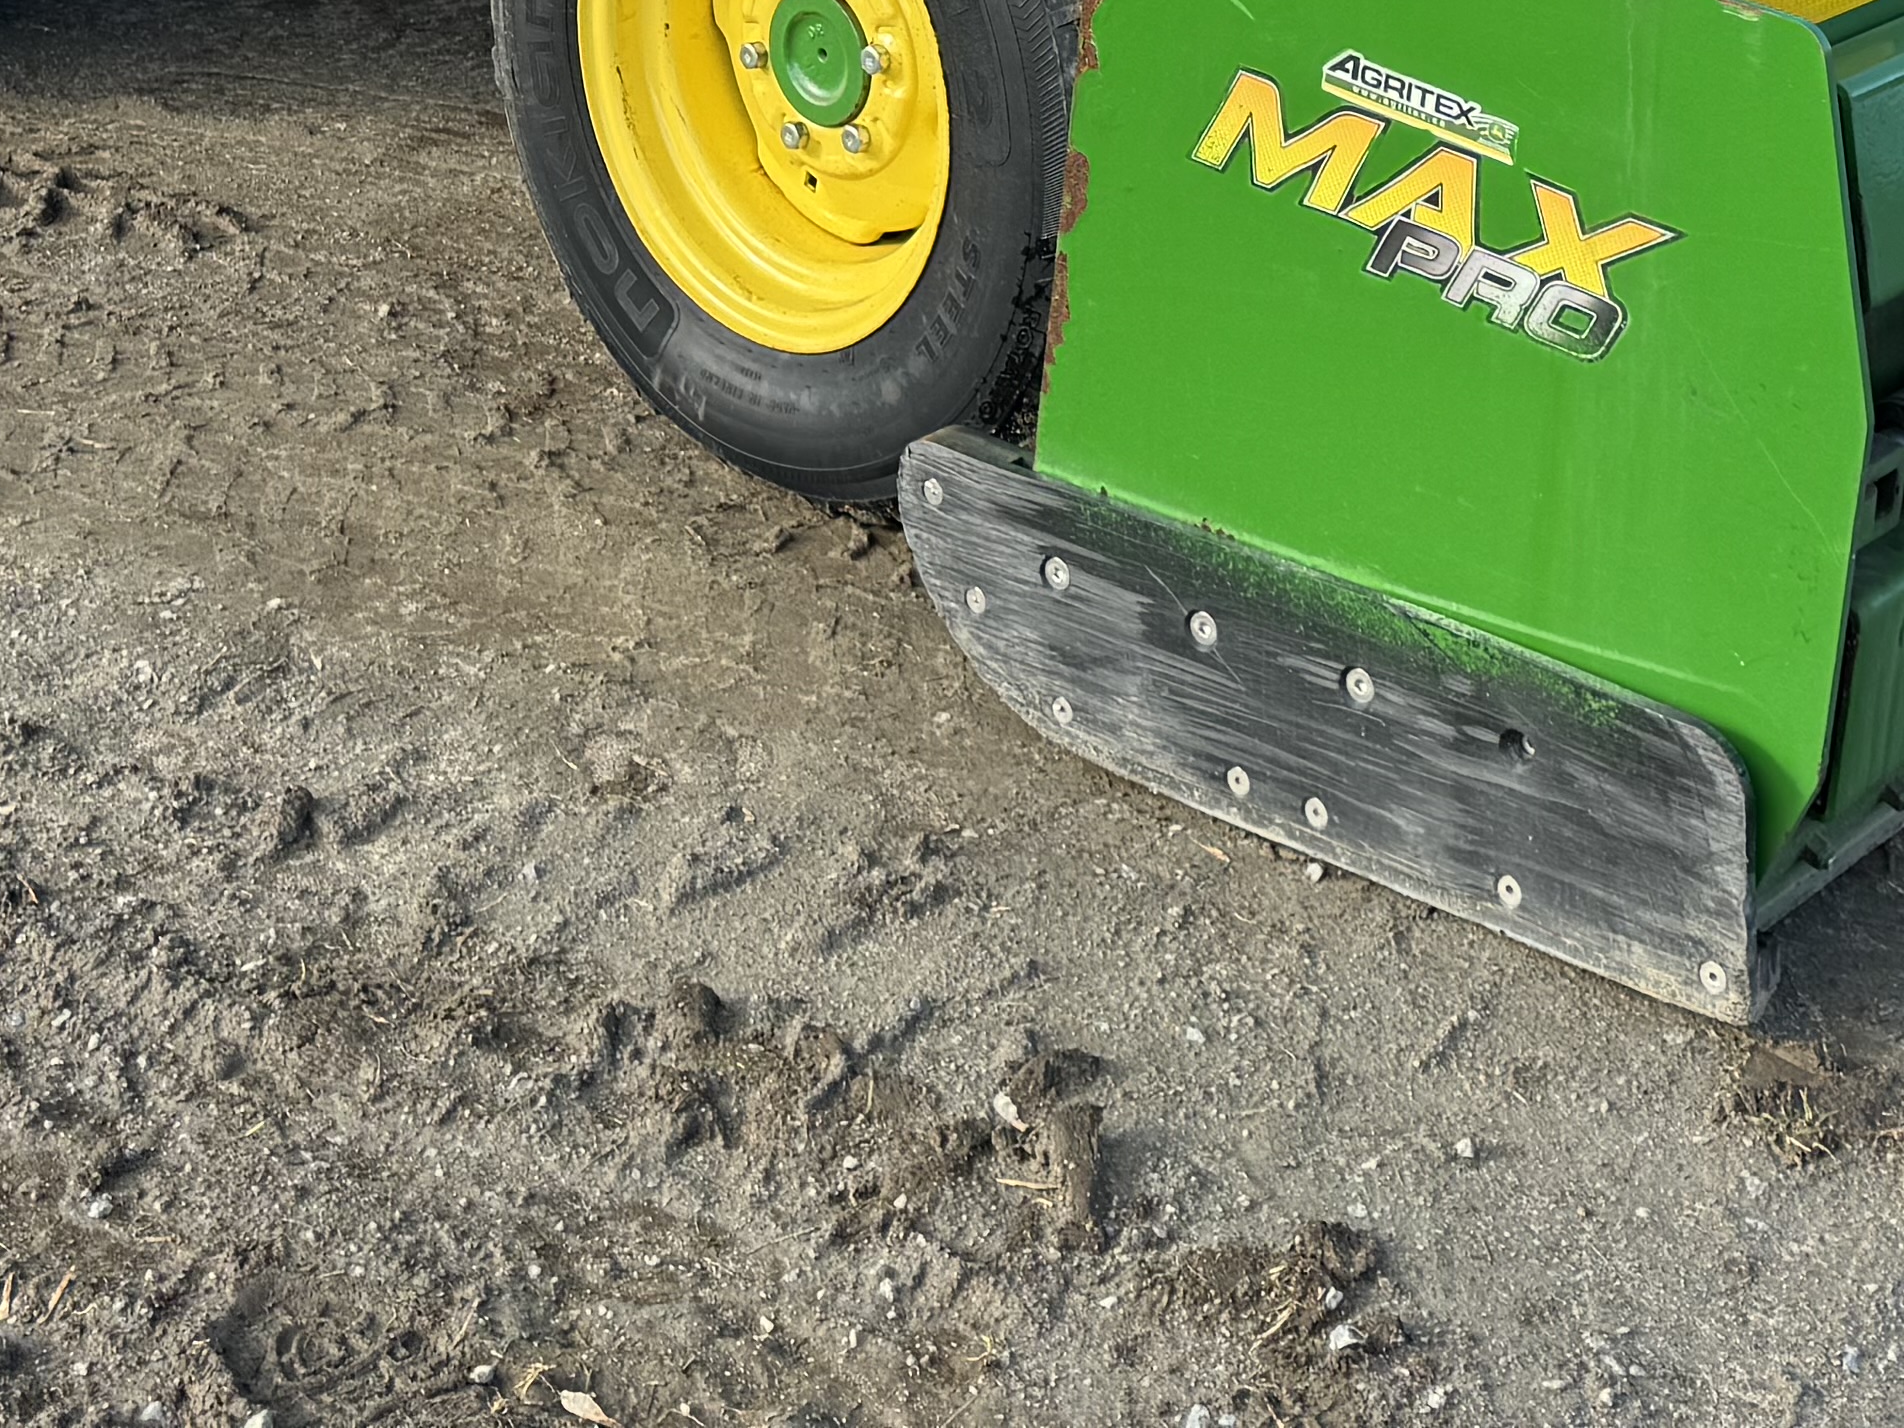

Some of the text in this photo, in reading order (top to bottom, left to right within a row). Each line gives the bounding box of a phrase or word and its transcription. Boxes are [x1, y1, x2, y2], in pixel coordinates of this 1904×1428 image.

[1327, 53, 1477, 128] AGRITEX
[1191, 69, 1682, 300] MAX
[914, 237, 982, 364] STEEL
[1365, 215, 1628, 363] PRO
